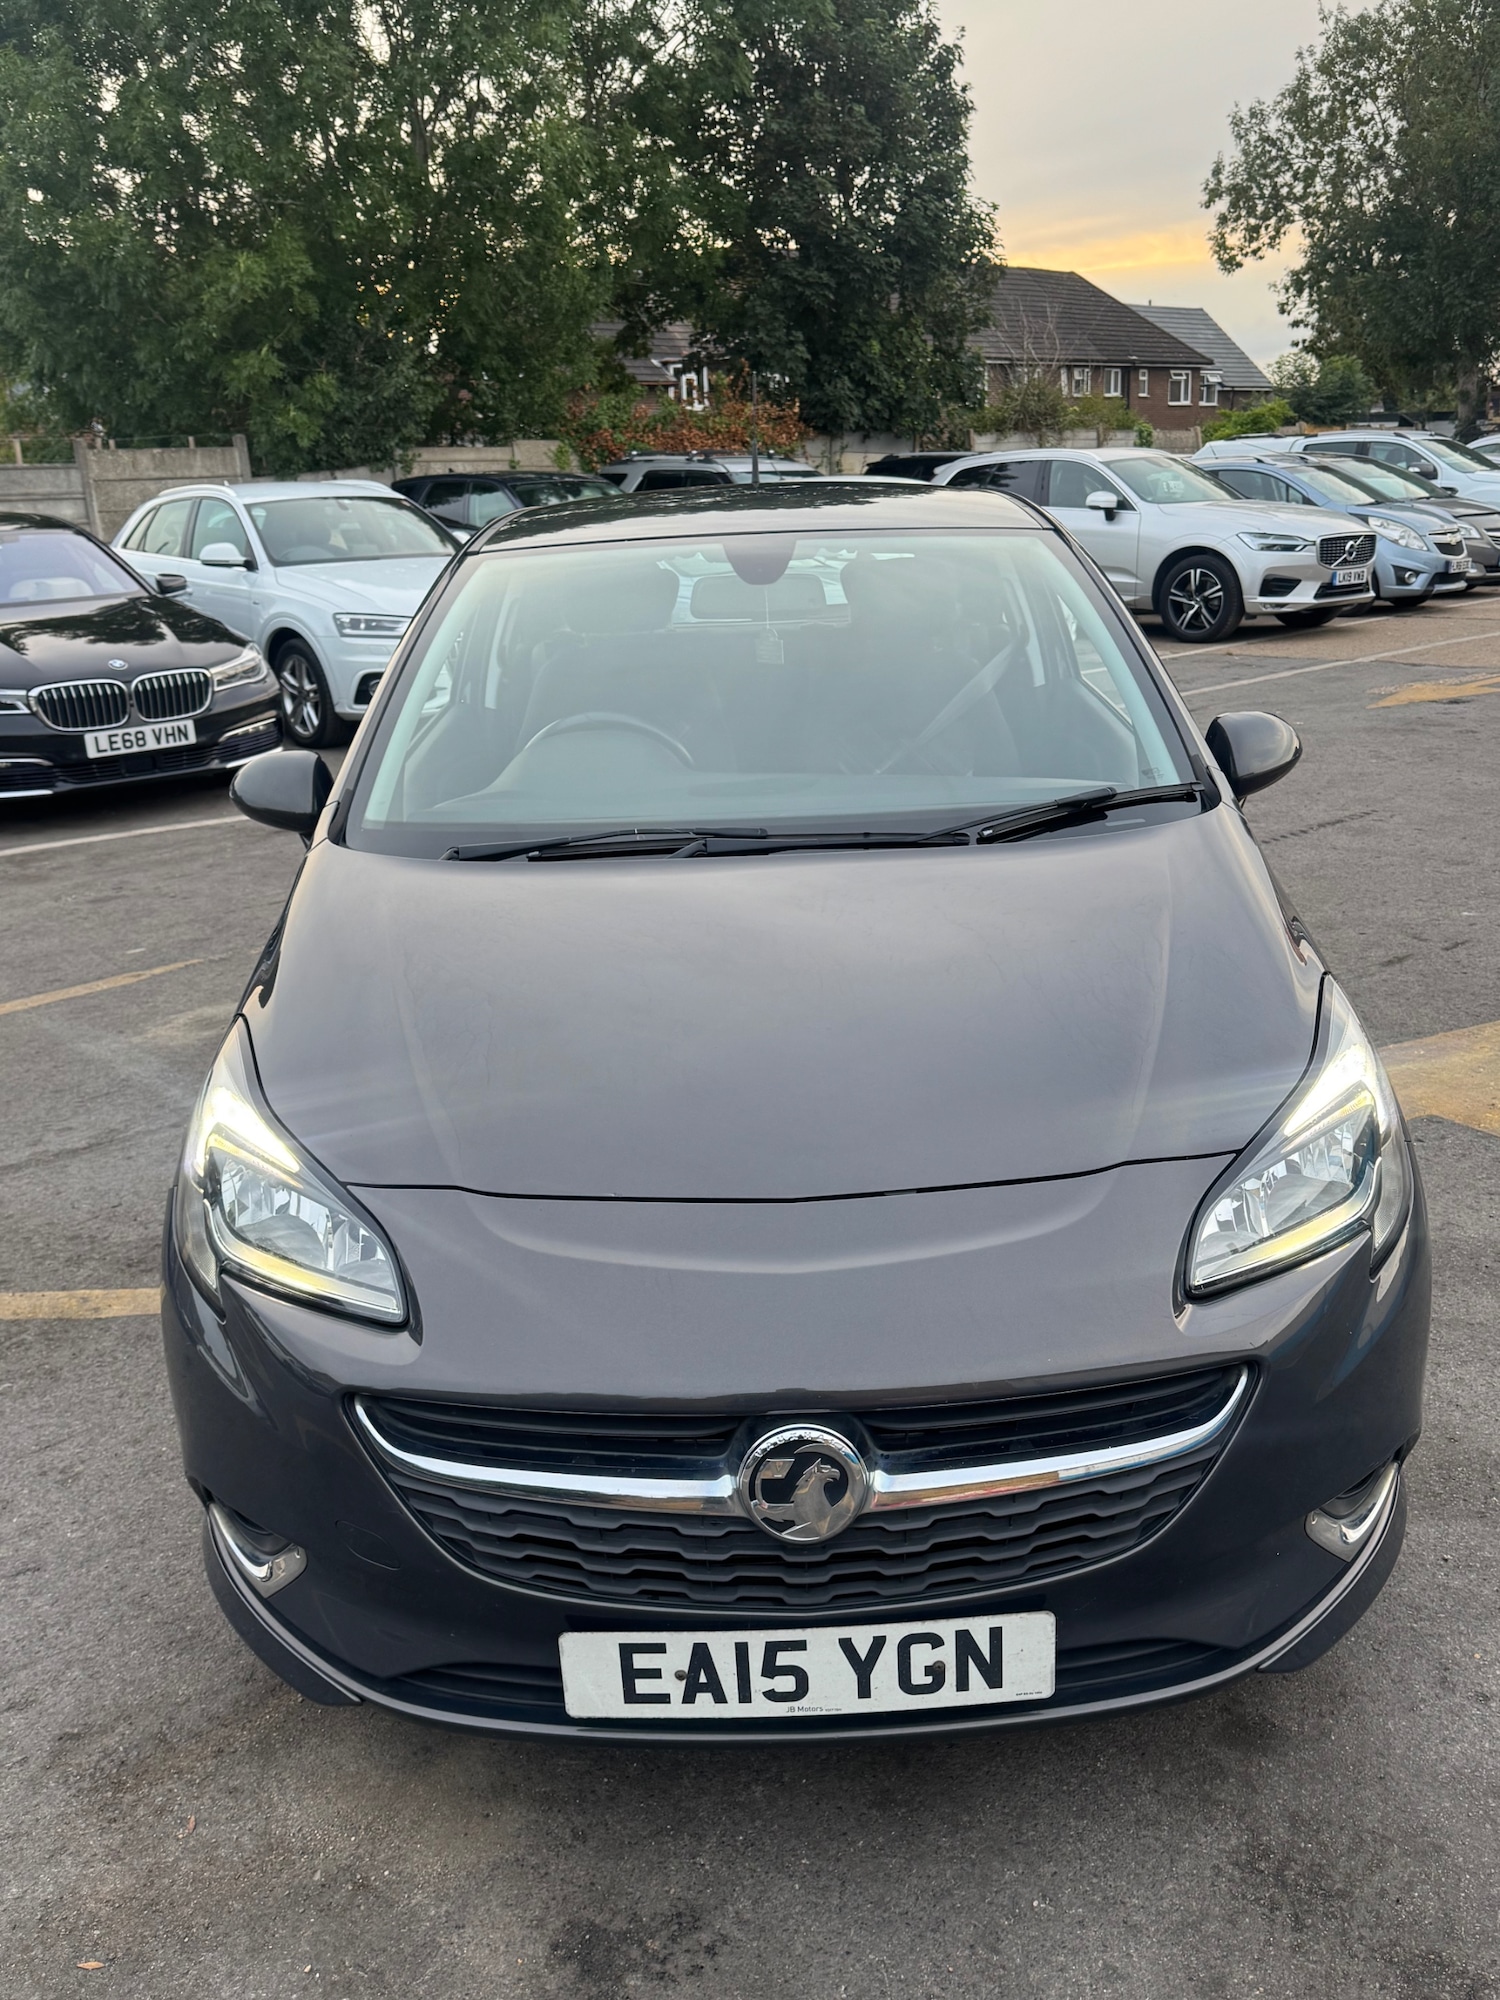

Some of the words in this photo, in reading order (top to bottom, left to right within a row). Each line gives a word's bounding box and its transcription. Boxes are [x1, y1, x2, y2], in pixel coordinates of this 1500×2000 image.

[94, 730, 147, 753] LE68
[151, 724, 190, 745] VHN
[618, 1638, 809, 1705] EA15
[838, 1626, 1004, 1699] YGN
[786, 1705, 796, 1713] JB
[797, 1705, 824, 1713] Motors
